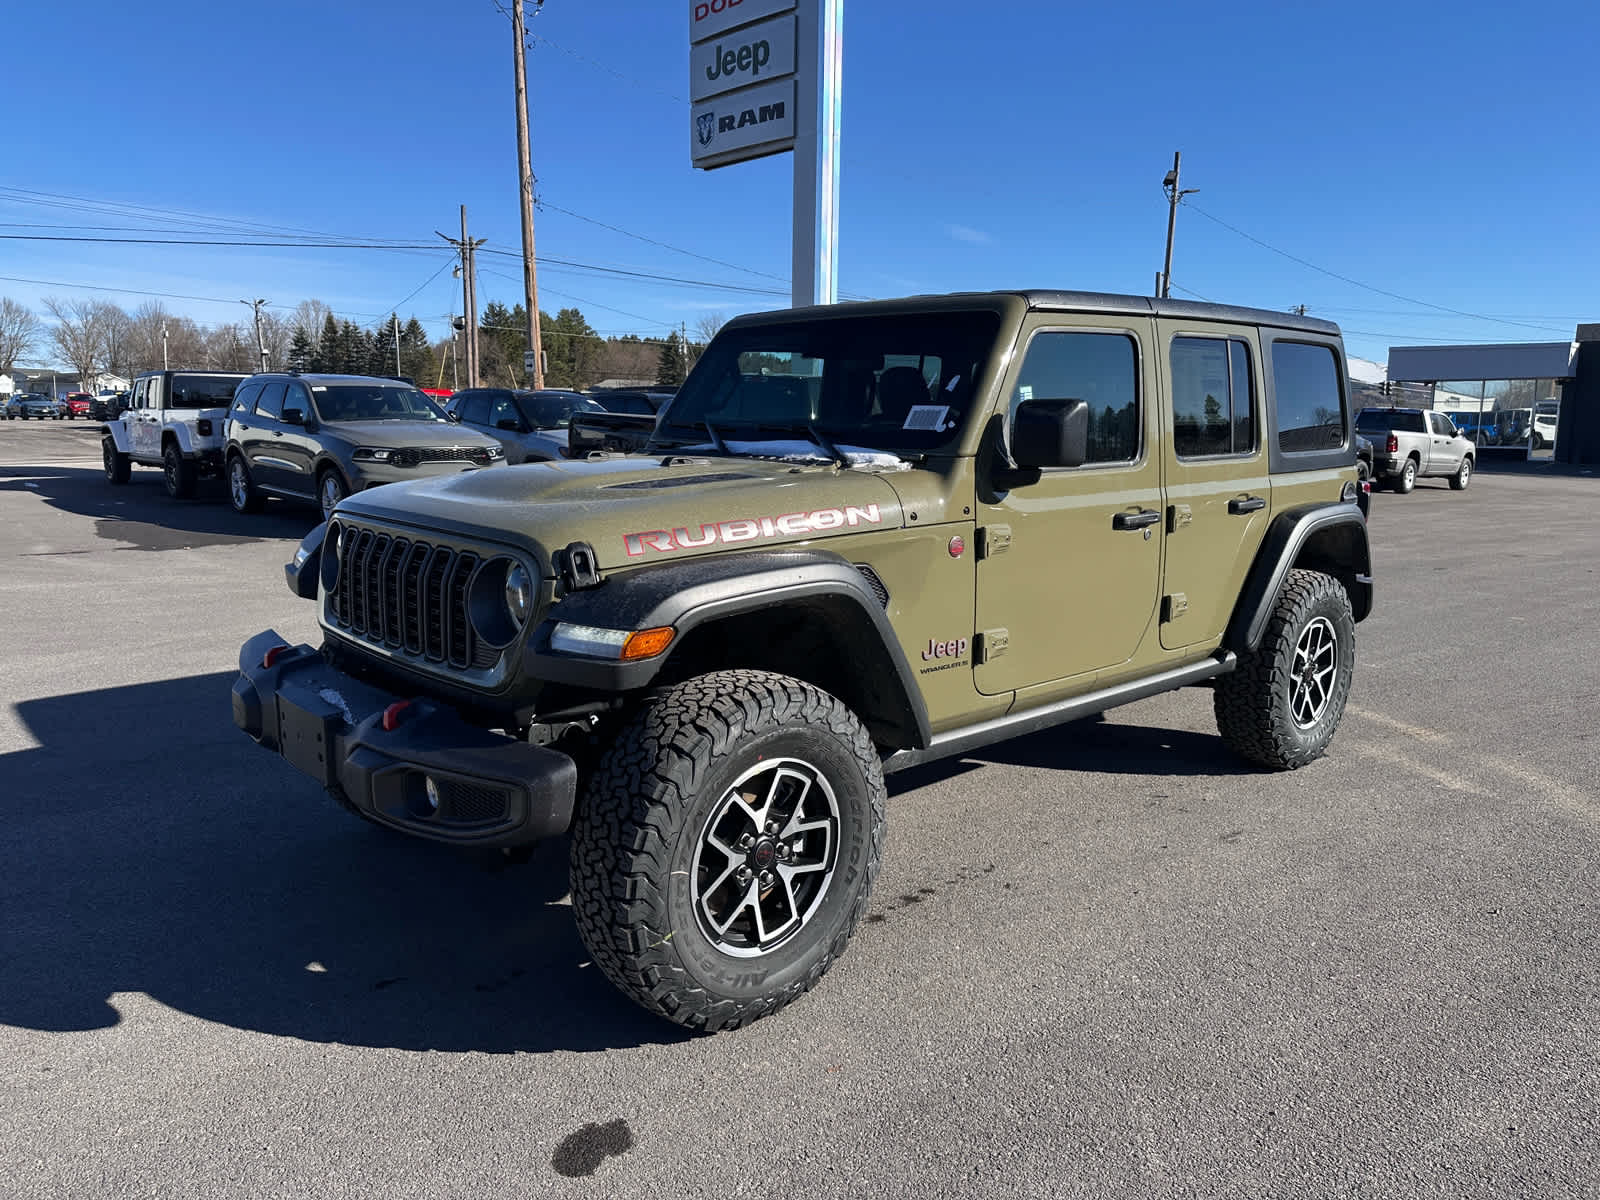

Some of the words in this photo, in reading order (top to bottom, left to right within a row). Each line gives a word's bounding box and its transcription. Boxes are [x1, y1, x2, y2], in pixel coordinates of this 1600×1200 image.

[706, 39, 770, 81] Jeep
[718, 102, 785, 133] RAM
[623, 503, 882, 557] RUBICON
[921, 637, 968, 662] Jeep
[920, 661, 960, 675] WRANGLER
